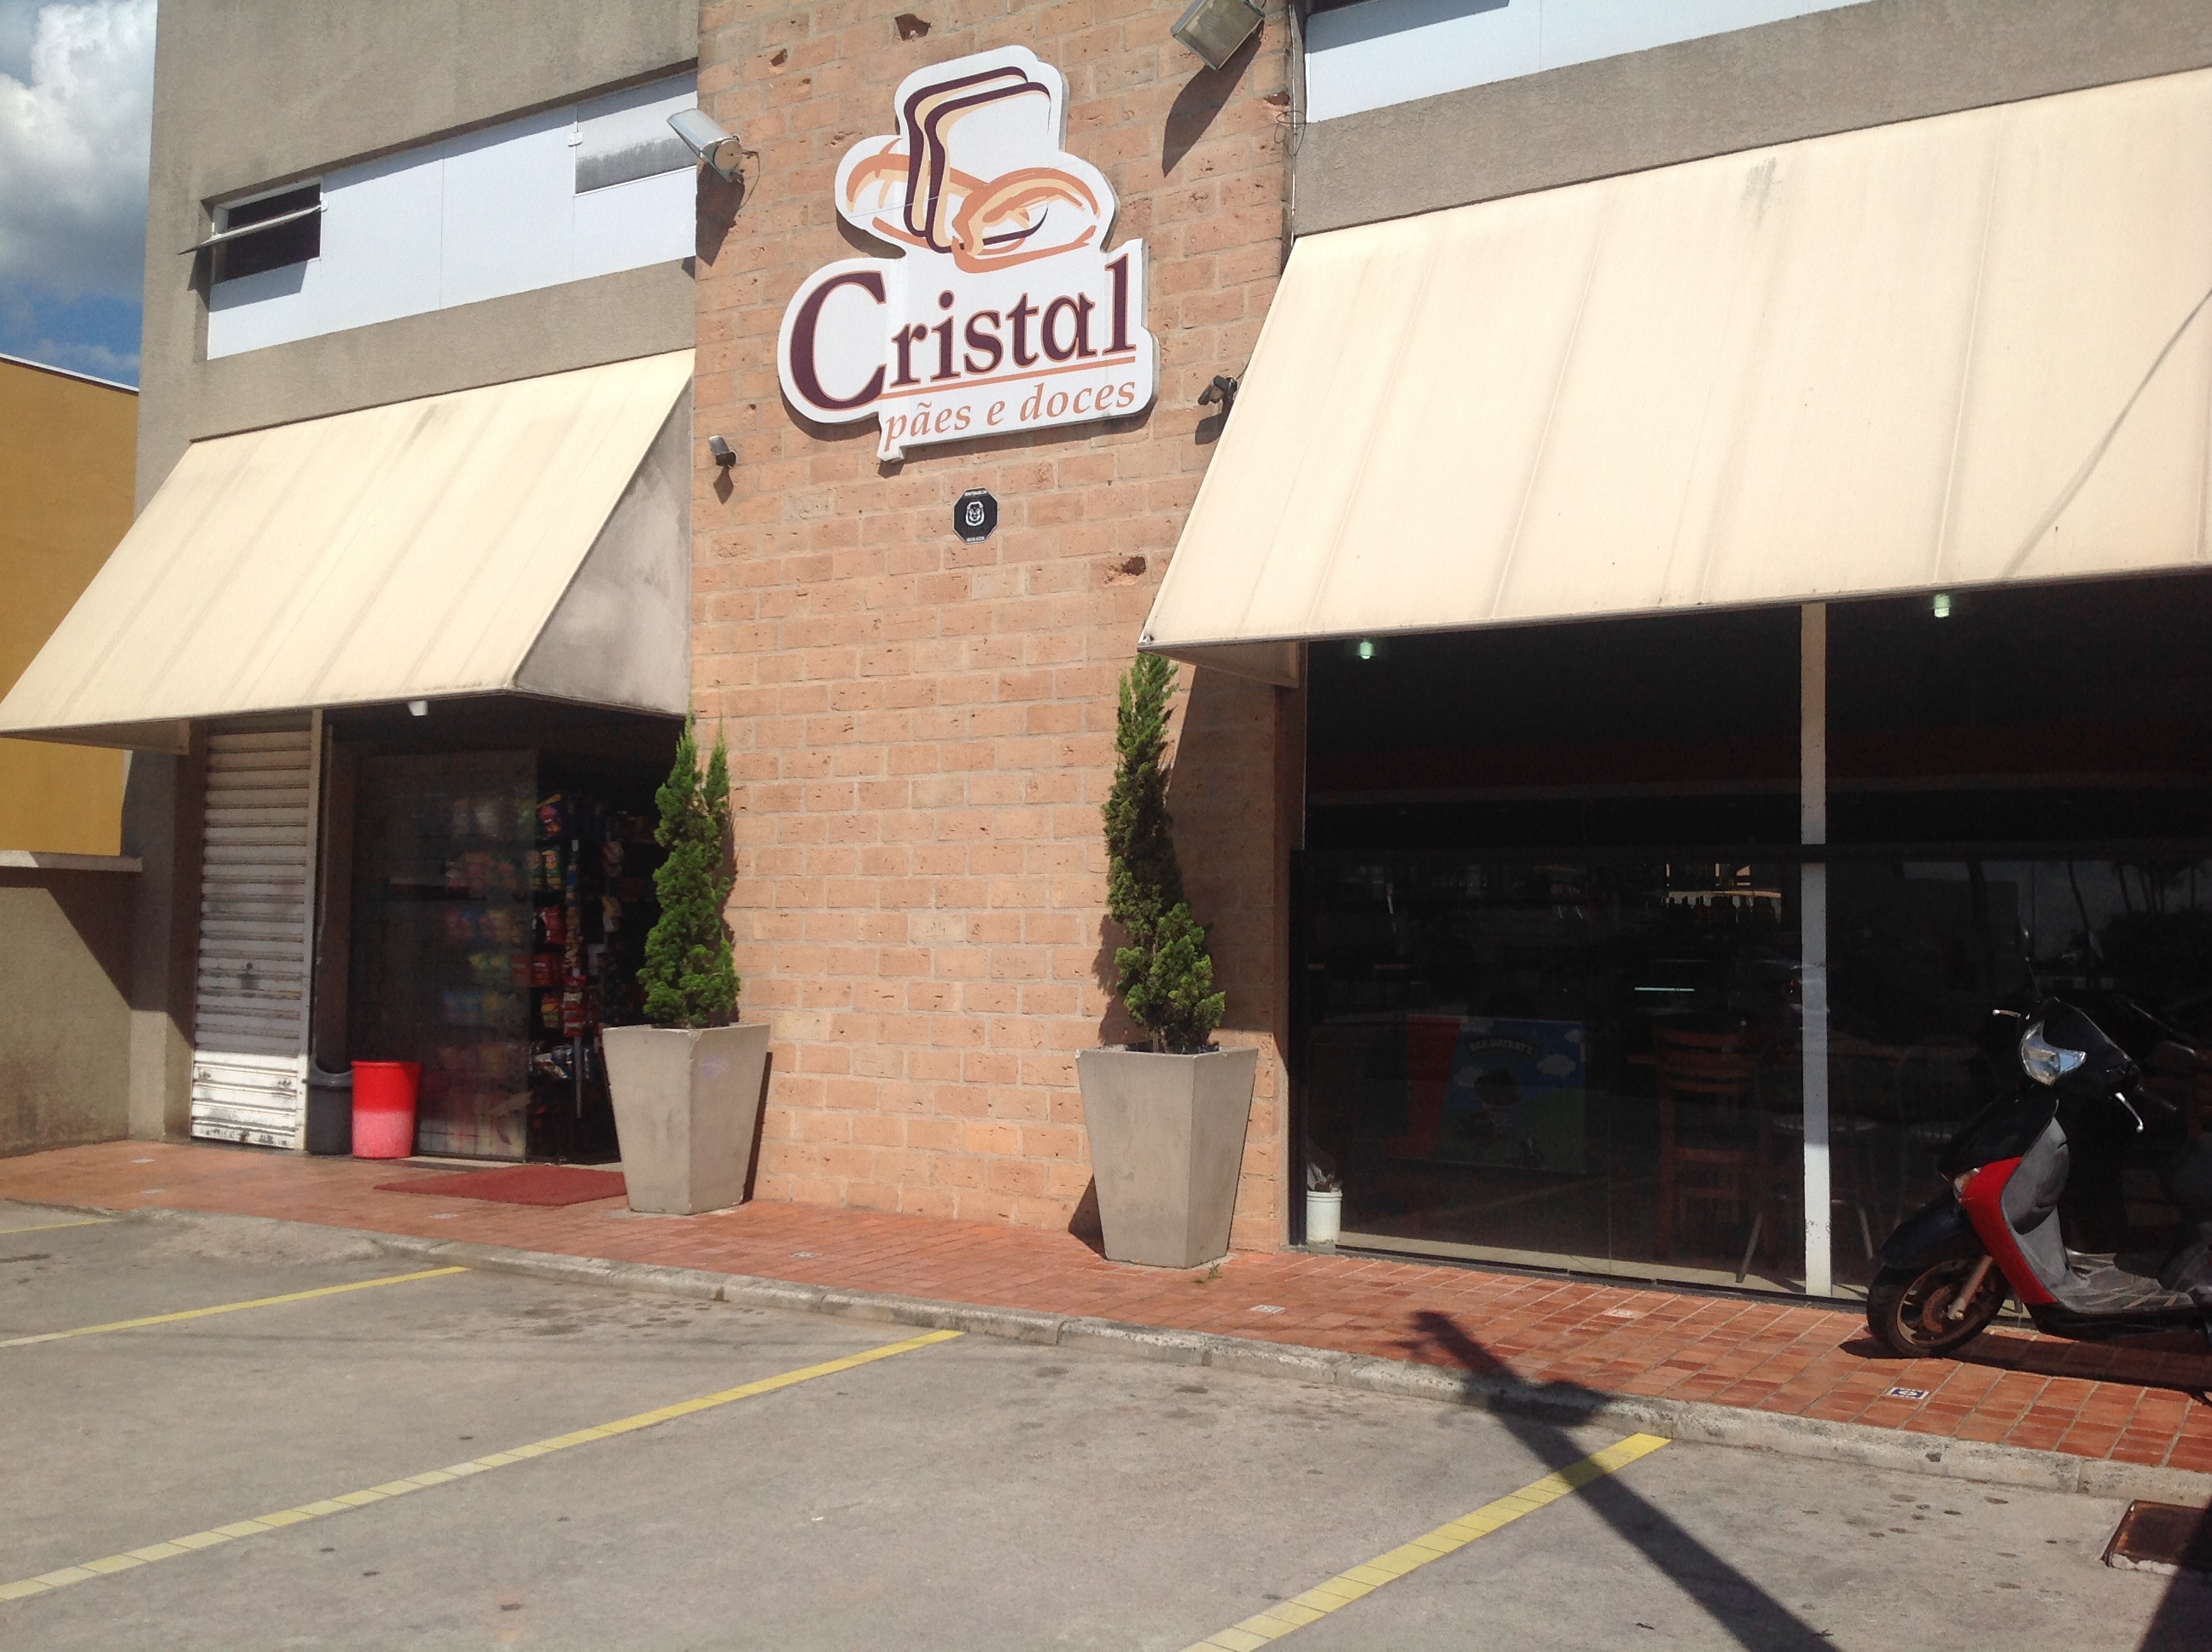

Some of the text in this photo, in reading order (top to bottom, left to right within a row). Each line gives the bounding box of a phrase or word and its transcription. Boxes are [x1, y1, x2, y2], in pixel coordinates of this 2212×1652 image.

[789, 253, 1137, 412] Cristal
[884, 381, 1136, 452] pães e doces
